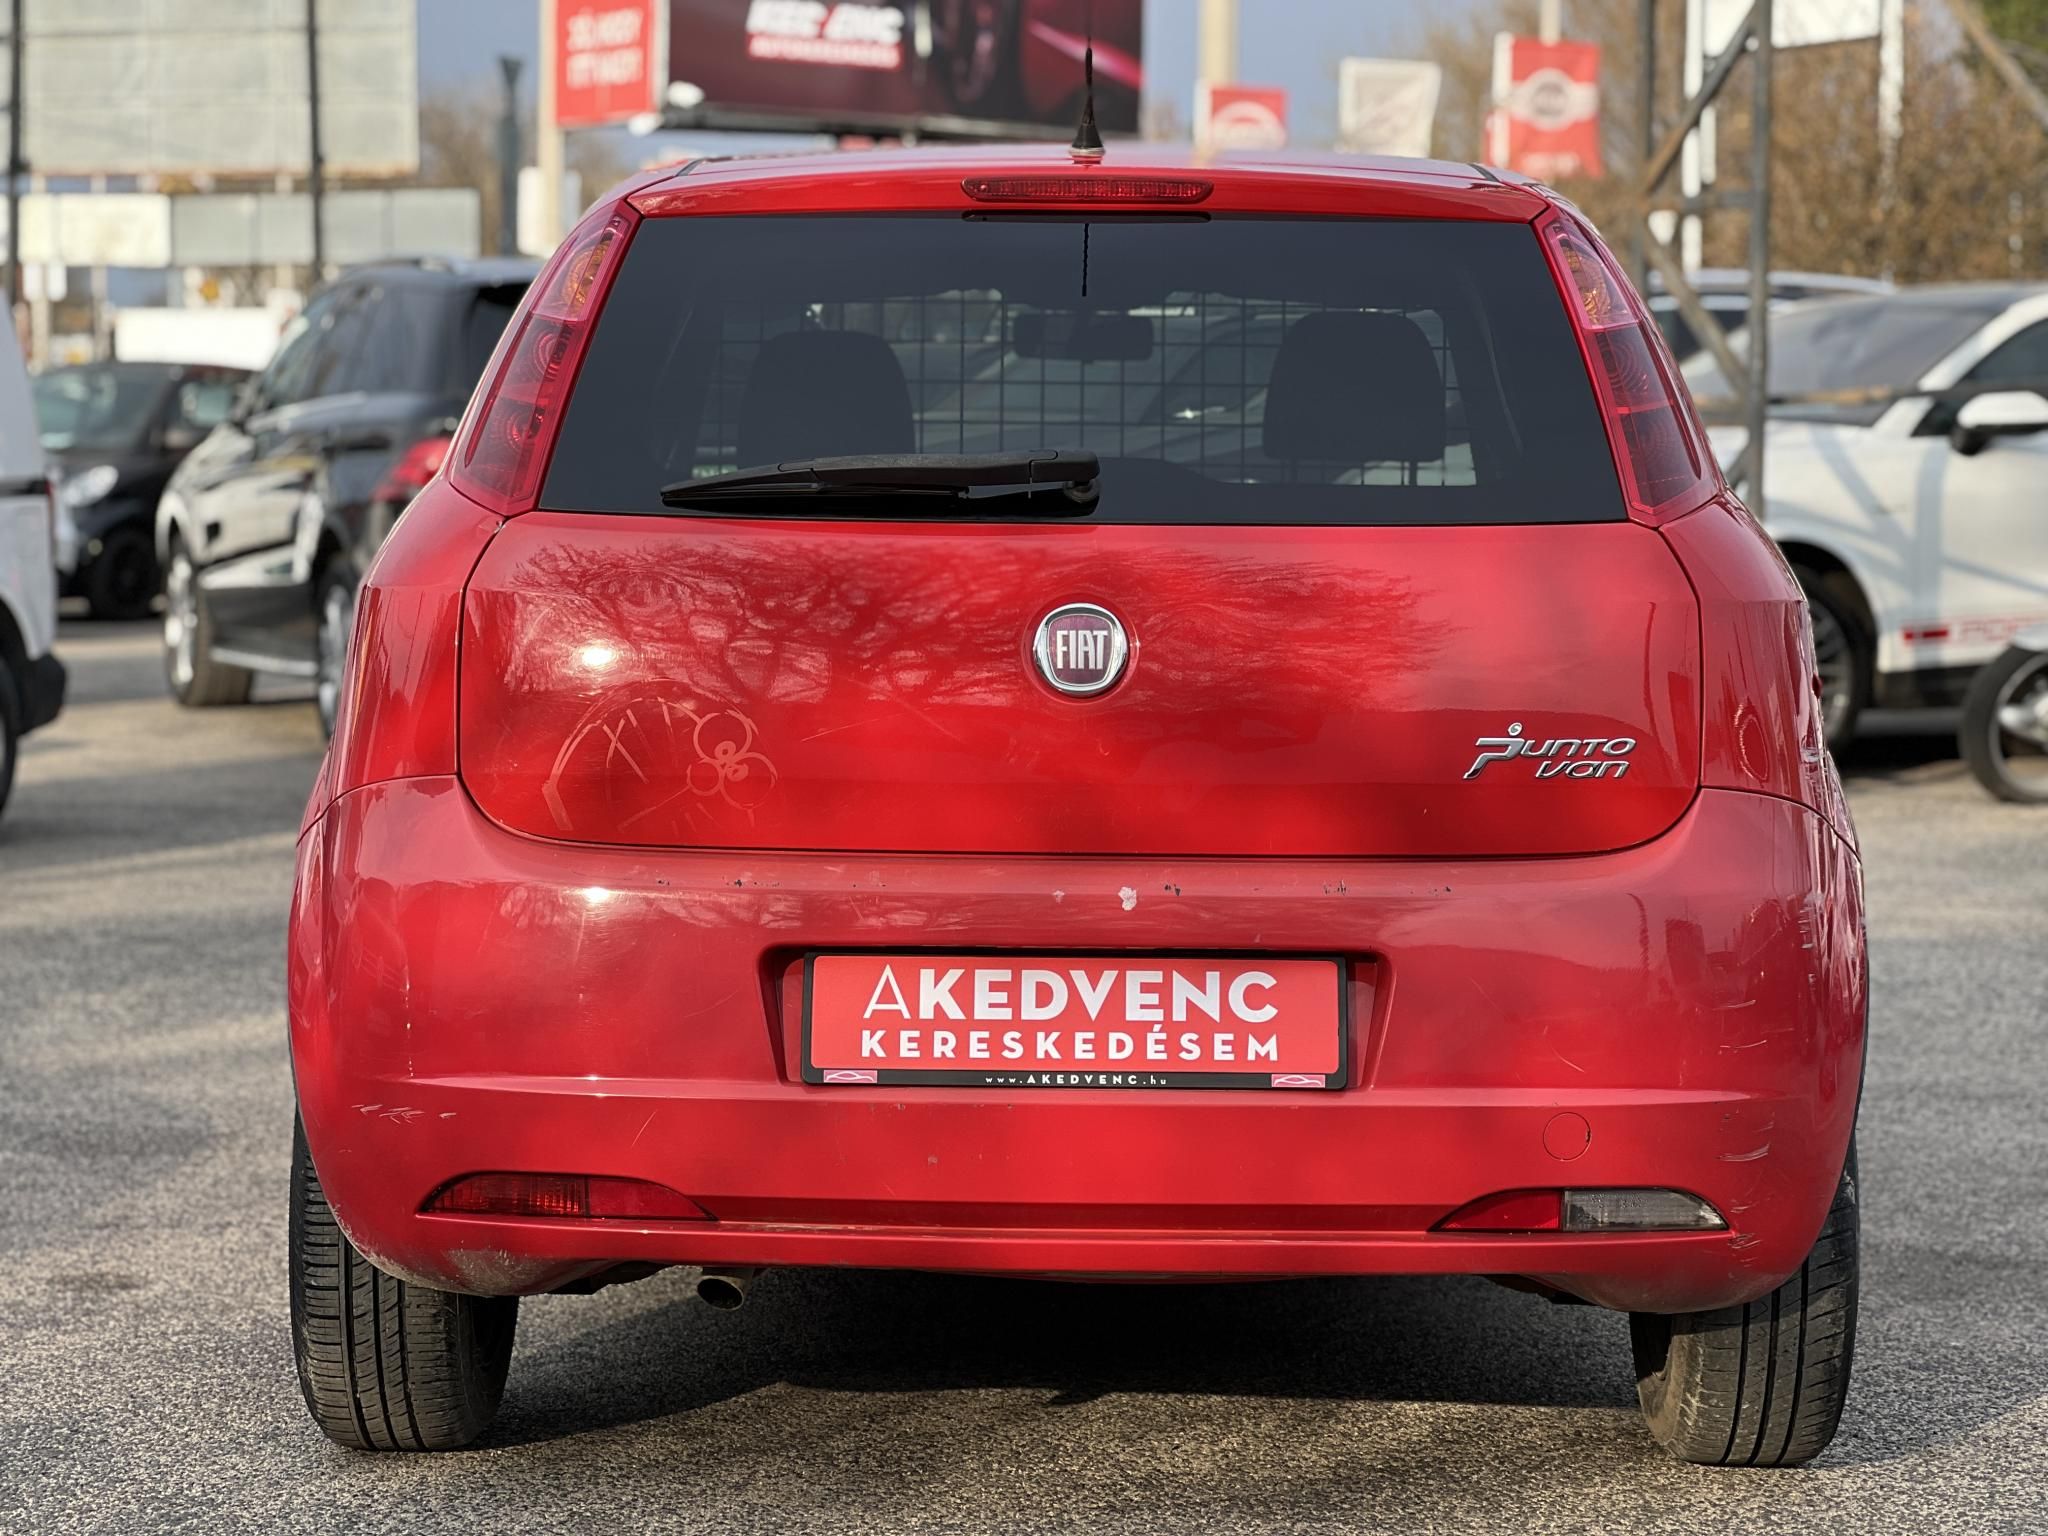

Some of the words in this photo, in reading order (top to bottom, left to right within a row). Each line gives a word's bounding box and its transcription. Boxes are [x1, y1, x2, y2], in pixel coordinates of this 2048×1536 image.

[1056, 629, 1109, 670] FIAT
[860, 1024, 1279, 1062] KERESKEDÉSEM
[985, 1074, 1168, 1087] www.AKEDVENC.hu
